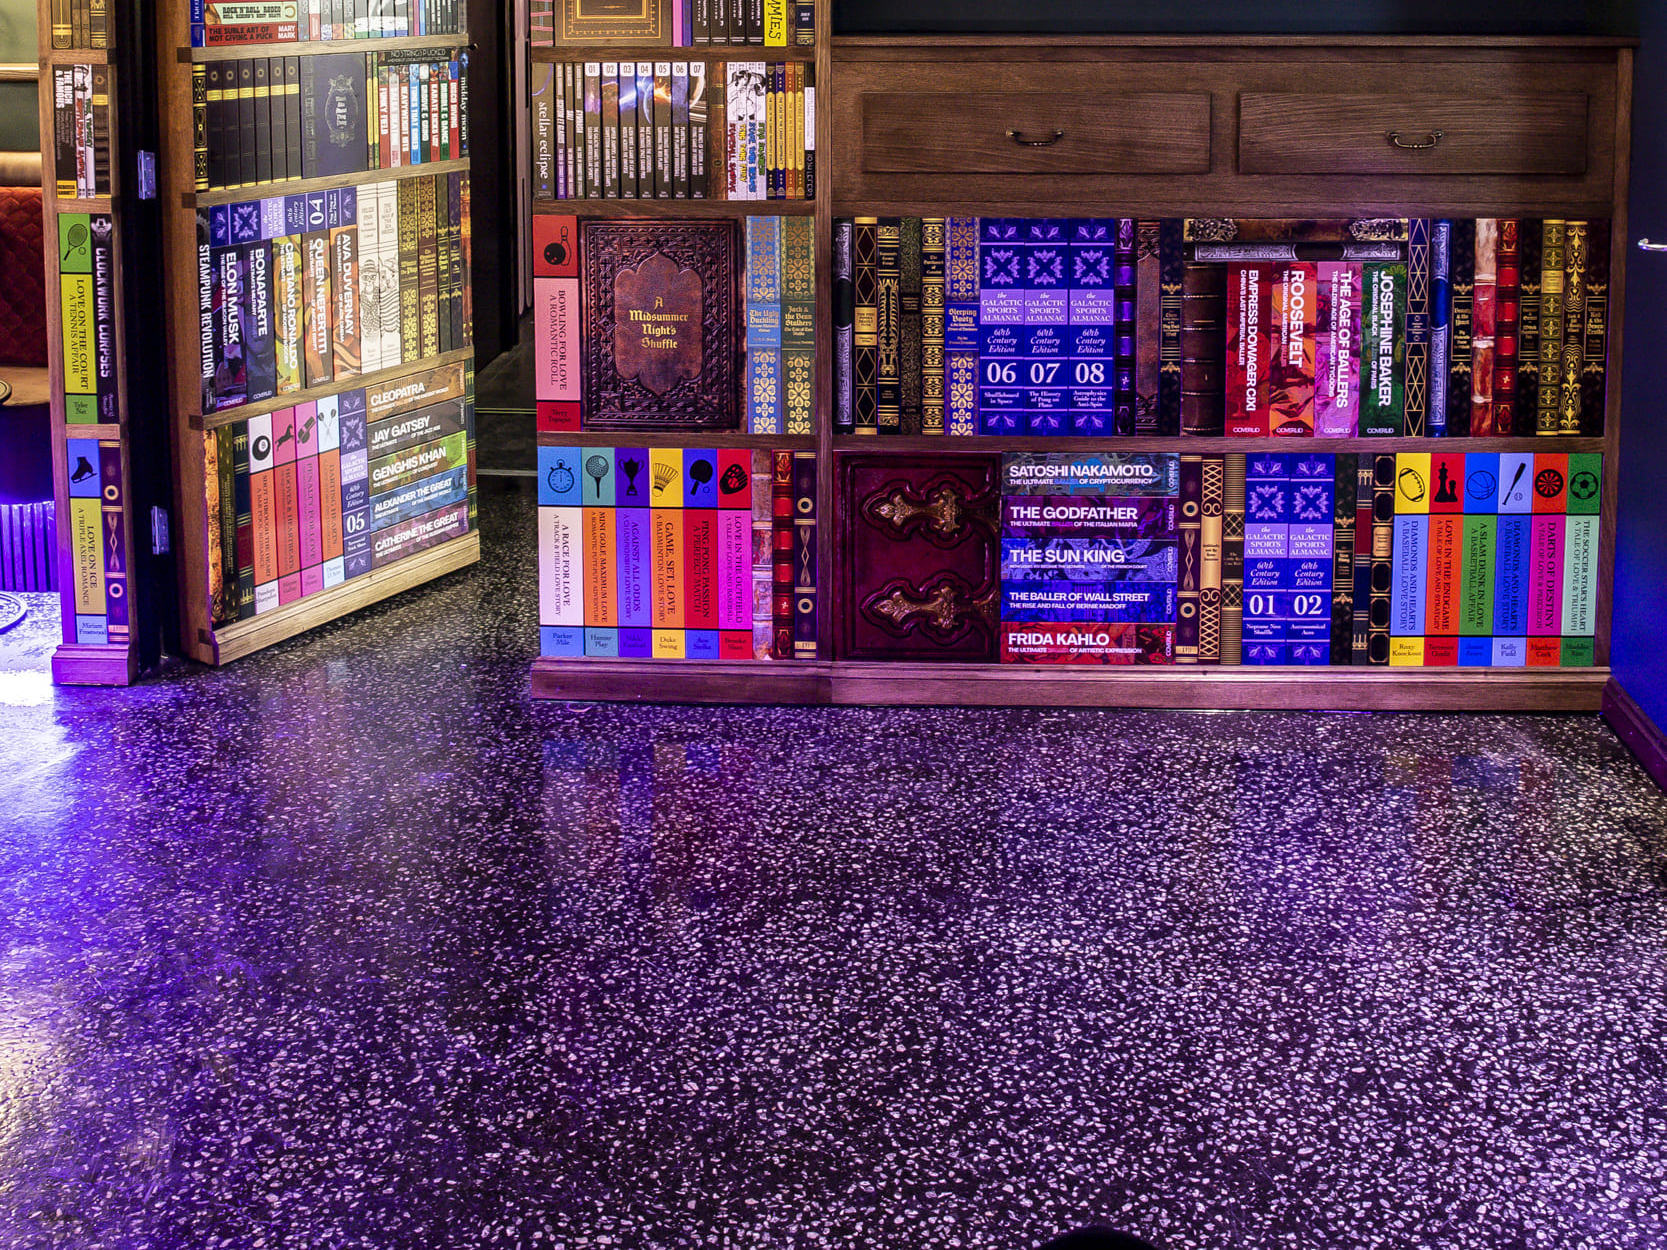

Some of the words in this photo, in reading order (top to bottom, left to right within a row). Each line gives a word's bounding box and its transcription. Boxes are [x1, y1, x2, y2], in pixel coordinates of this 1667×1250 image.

[278, 25, 296, 33] MARY
[64, 70, 73, 85] THE
[588, 65, 596, 73] 01
[606, 65, 614, 73] 02
[623, 65, 632, 73] 03
[640, 65, 649, 73] 04
[658, 65, 667, 73] 05
[675, 65, 684, 73] 06
[693, 65, 701, 73] 07
[55, 77, 65, 108] FAMOUS
[64, 86, 73, 104] RICH
[539, 101, 552, 138] stellar
[536, 140, 552, 180] eclipse
[309, 198, 324, 225] 04
[342, 234, 352, 260] AVA
[226, 252, 238, 293] ELON
[313, 238, 325, 285] QUEEN
[96, 248, 110, 320] CLOCKWORK
[199, 244, 211, 310] STEAMPUNK
[286, 242, 297, 307] CRISTIANO
[1340, 270, 1352, 297] THE
[76, 279, 85, 308] LOVE
[255, 248, 268, 336] BONAPARTE
[343, 262, 354, 335] DUVERNAY
[654, 296, 664, 308] A
[1248, 270, 1259, 324] EMPRESS
[78, 310, 86, 327] ON
[228, 296, 239, 344] MUSK
[316, 288, 327, 355] NEFERTITI
[558, 290, 567, 338] BOWLING
[629, 310, 688, 322] Midsummer
[982, 314, 1022, 322] ALMANAC
[1289, 270, 1305, 368] ROOSEVELT
[1340, 300, 1352, 328] AGE
[1380, 270, 1394, 355] JOSEPHINE
[79, 328, 87, 350] THE
[287, 309, 298, 369] RONALDO
[641, 324, 677, 337] Night's
[987, 336, 1017, 346] Century
[1338, 329, 1350, 349] OF
[98, 324, 113, 378] CORPSES
[201, 312, 215, 378] REVOLUTION
[558, 341, 567, 362] FOR
[641, 338, 678, 349] Shuffle
[988, 345, 1015, 354] Edition
[1247, 326, 1258, 386] DOWAGER
[80, 353, 89, 389] COURT
[559, 363, 568, 390] LOVE
[987, 362, 1017, 383] 06
[1030, 363, 1060, 384] 07
[1075, 362, 1105, 384] 08
[1336, 350, 1349, 408] BALLERS
[1379, 356, 1392, 406] BAKER
[371, 382, 425, 406] CLEOPATRA
[1246, 388, 1257, 411] CIXI
[372, 428, 391, 444] JAY
[391, 416, 430, 437] GATSBY
[372, 456, 419, 481] GENGHIS
[418, 446, 447, 463] KHAN
[1009, 465, 1069, 478] SATOSHI
[1070, 464, 1153, 477] NAKAMOTO
[374, 490, 417, 513] ALEXANDER
[416, 486, 430, 498] THE
[429, 477, 453, 493] GREAT
[346, 513, 365, 533] 05
[1010, 506, 1041, 519] THE
[1043, 506, 1138, 520] GODFATHER
[87, 526, 96, 553] LOVE
[374, 527, 419, 551] CATHERINE
[419, 523, 433, 535] THE
[433, 511, 459, 528] GREAT
[665, 522, 675, 557] GAME,
[1546, 522, 1556, 558] DARTS
[561, 533, 570, 557] RACE
[1010, 549, 1041, 563] THE
[1044, 549, 1080, 563] SUN
[1083, 549, 1125, 563] KING
[1410, 521, 1419, 571] DIAMONDS
[88, 554, 97, 570] ON
[562, 560, 570, 579] FOR
[665, 560, 675, 581] SET,
[1546, 561, 1556, 576] OF
[89, 572, 97, 588] ICE
[1409, 573, 1418, 591] AND
[563, 581, 571, 606] LOVE
[667, 585, 675, 615] LOVE
[1009, 592, 1030, 601] THE
[1030, 592, 1067, 601] BALLER
[1068, 592, 1081, 601] OF
[1081, 592, 1111, 602] WALL
[1113, 593, 1150, 602] STREET
[1249, 594, 1275, 615] 01
[1293, 594, 1323, 615] 02
[1545, 580, 1555, 629] DESTINY
[1408, 595, 1417, 630] HEARTS
[1008, 633, 1053, 645] FRIDA
[1057, 633, 1110, 646] KAHLO
